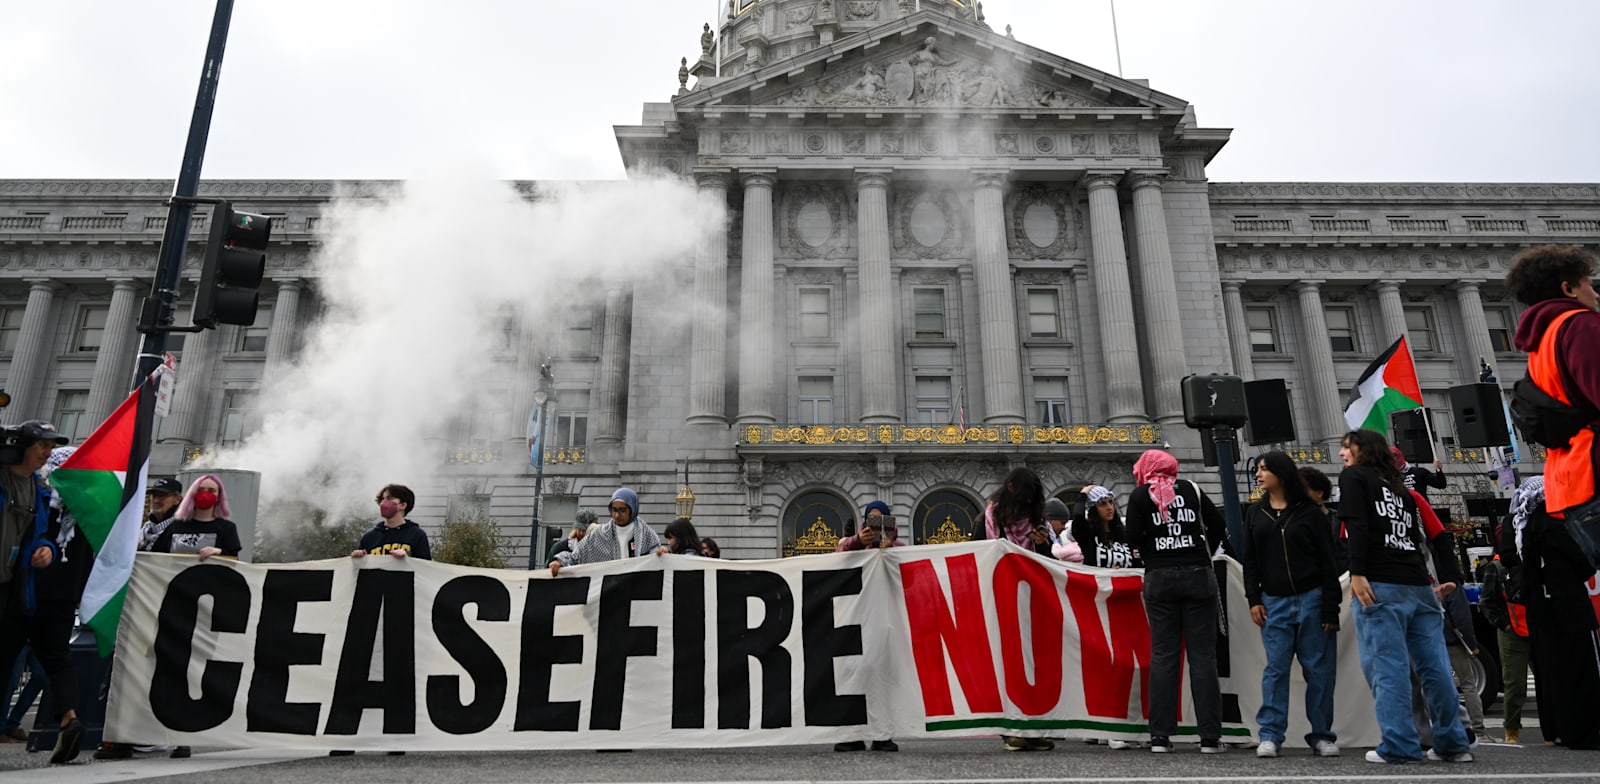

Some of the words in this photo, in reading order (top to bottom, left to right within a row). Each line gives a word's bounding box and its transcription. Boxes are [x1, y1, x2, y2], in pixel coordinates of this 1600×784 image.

[1177, 508, 1196, 522] AID
[1167, 523, 1181, 536] TO
[1390, 519, 1406, 537] TO
[1155, 535, 1196, 551] ISRAEL
[1096, 547, 1133, 569] FIRE
[149, 564, 868, 735] CEASEFIRE
